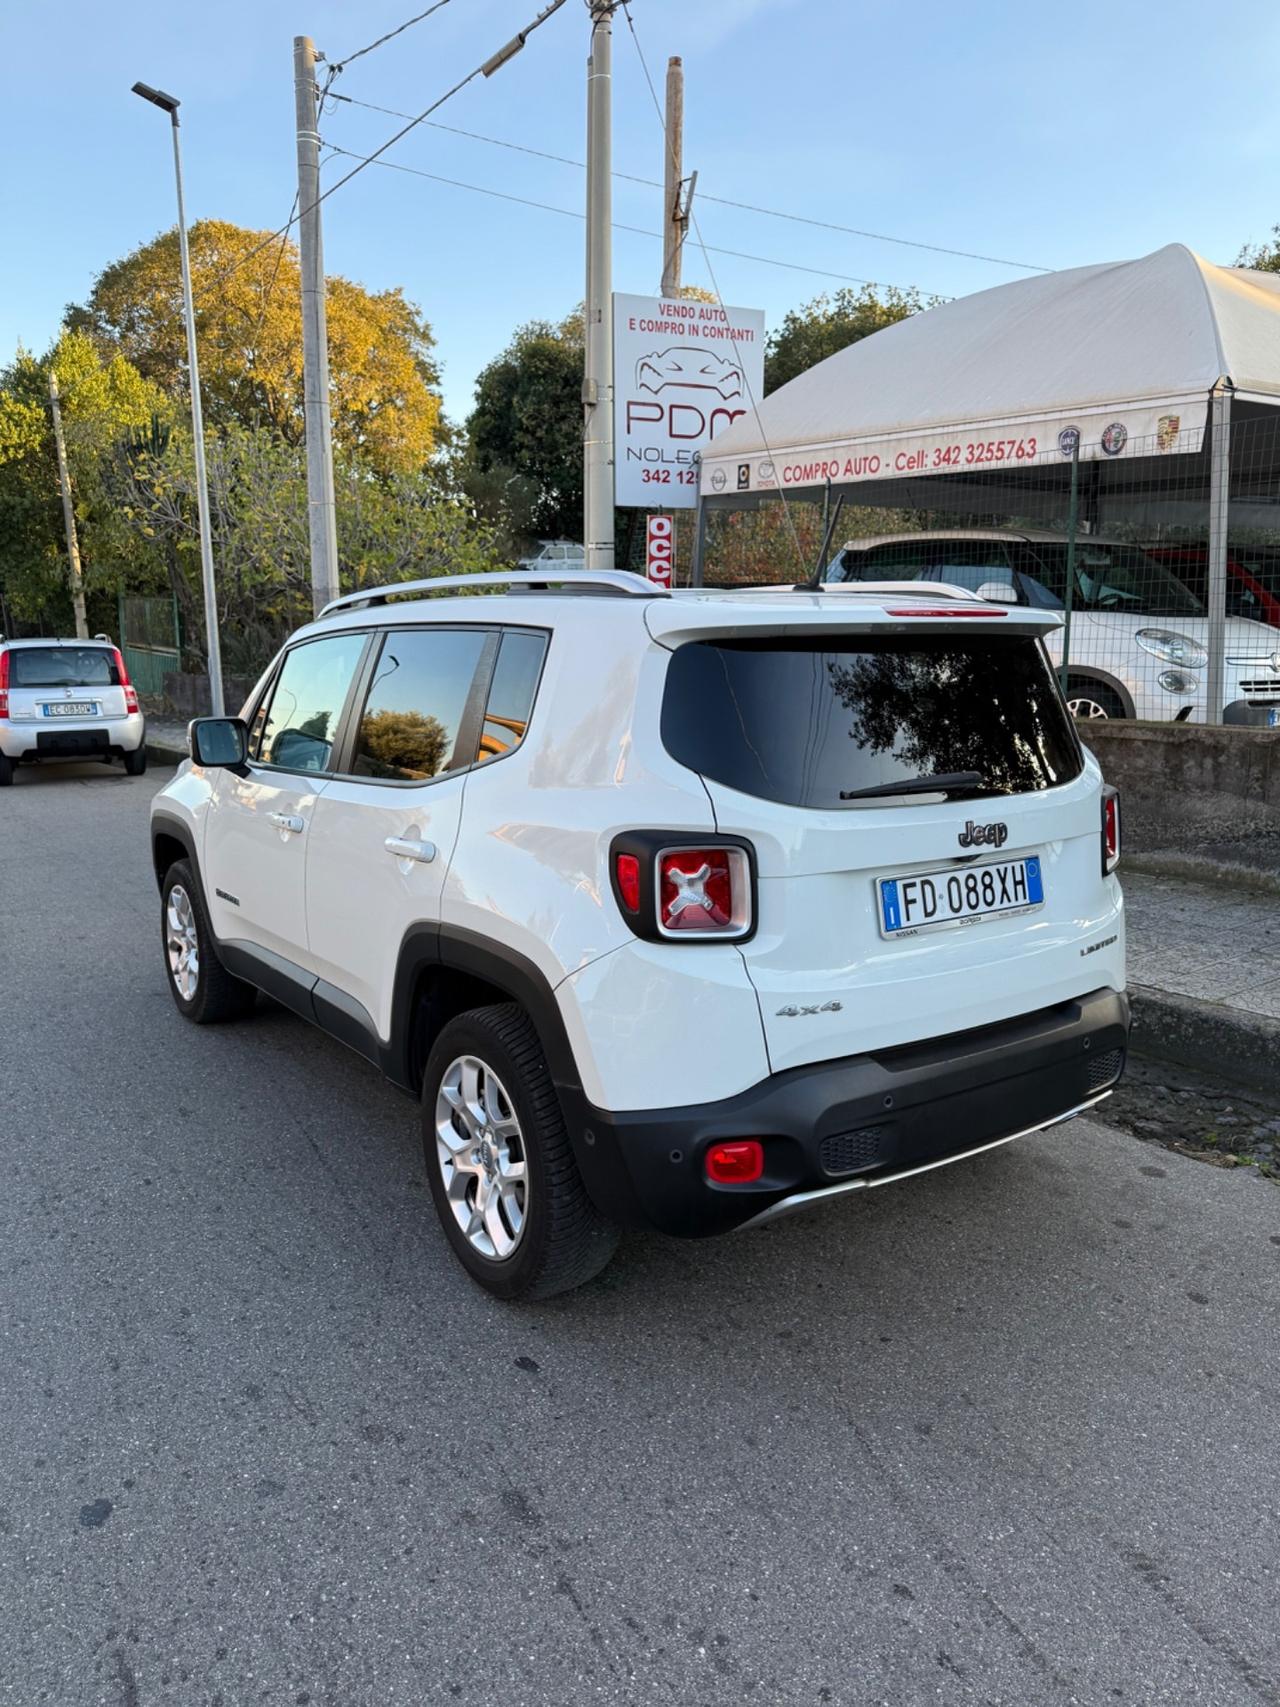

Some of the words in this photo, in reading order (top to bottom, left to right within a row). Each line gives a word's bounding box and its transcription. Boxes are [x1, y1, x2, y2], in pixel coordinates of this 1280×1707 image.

[658, 303, 695, 319] VENDO
[698, 308, 727, 322] AUTO
[628, 317, 637, 331] E
[639, 319, 685, 335] COMPRO
[688, 324, 700, 337] IN
[702, 325, 754, 342] CONTANTI
[783, 459, 839, 483] COMPRO
[843, 455, 880, 477] AUTO
[895, 449, 929, 471] Cell:
[933, 445, 961, 467] 342
[965, 438, 1037, 464] 3255763
[642, 469, 671, 484] 342
[958, 820, 1008, 848] Jeep
[901, 878, 938, 922] FD
[946, 863, 1029, 914] 088XH
